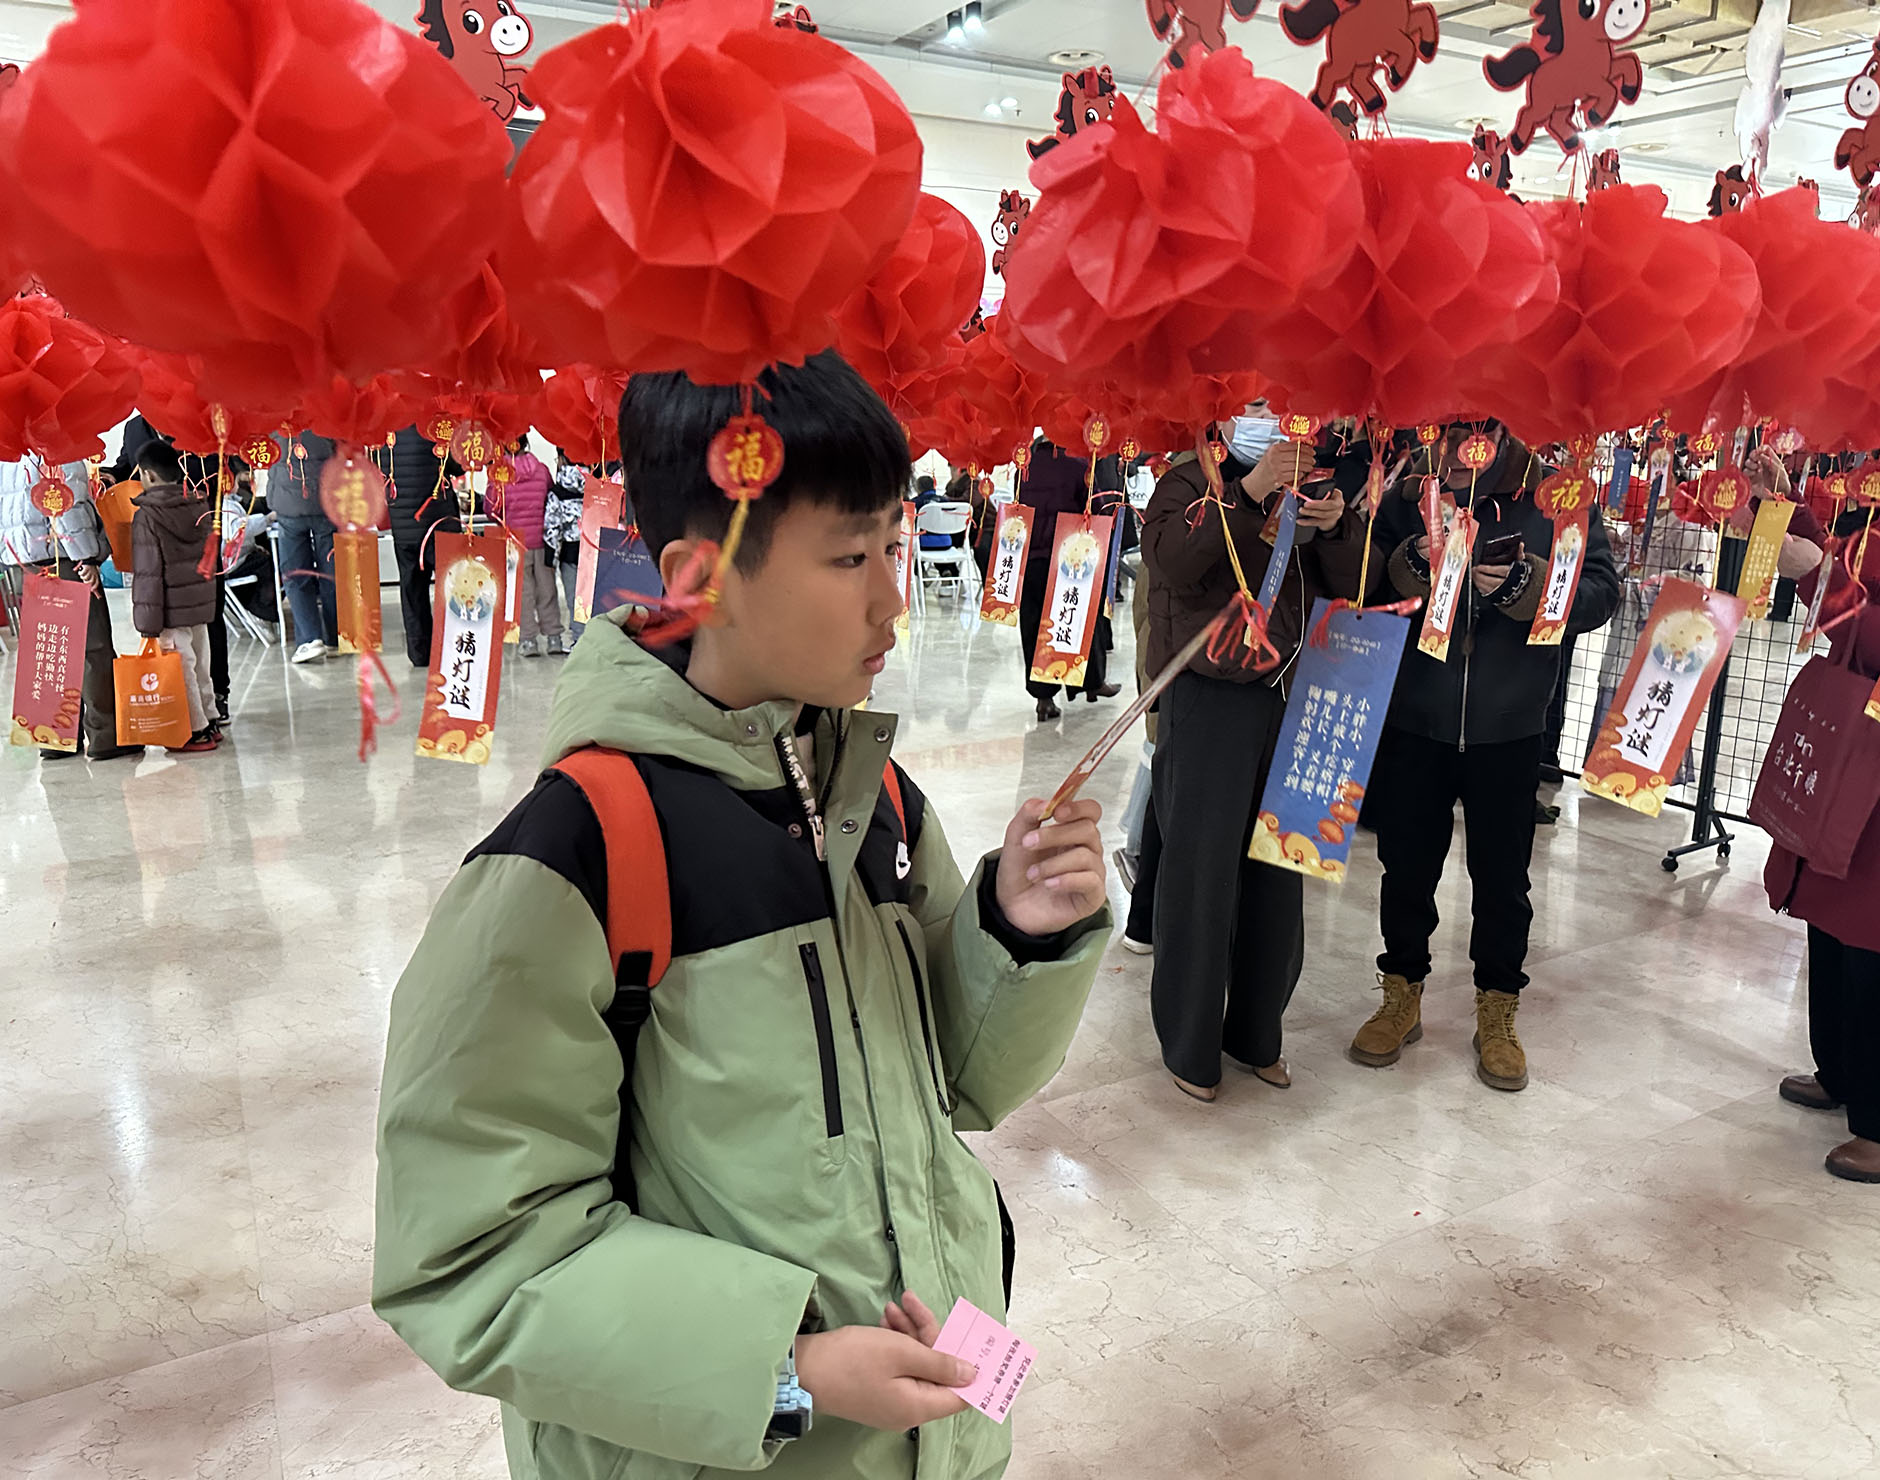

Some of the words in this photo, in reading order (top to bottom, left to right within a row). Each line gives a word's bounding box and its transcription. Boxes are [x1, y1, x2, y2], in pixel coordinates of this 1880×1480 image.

[247, 441, 271, 464] 福
[461, 431, 484, 461] 福
[1123, 442, 1134, 458] 福
[1422, 427, 1434, 440] 福
[1467, 442, 1486, 462] 福
[1695, 433, 1714, 452] 福
[1776, 432, 1795, 451] 福
[725, 432, 764, 483] 福
[333, 470, 369, 525] 福
[1552, 479, 1583, 510] 福
[997, 554, 1014, 598] 猜灯谜
[1434, 573, 1452, 624] 猜灯谜
[1547, 568, 1568, 615] 猜灯谜
[1055, 586, 1080, 646] 猜灯谜
[31, 621, 47, 700] 妈妈的帮手大家爱
[450, 630, 477, 710] 猜灯谜
[1626, 680, 1674, 757] 猜灯谜
[979, 1339, 1021, 1410] 每张抽奖券猜一个灯谜
[998, 1355, 1032, 1414] 凭此券参加猜灯谜
